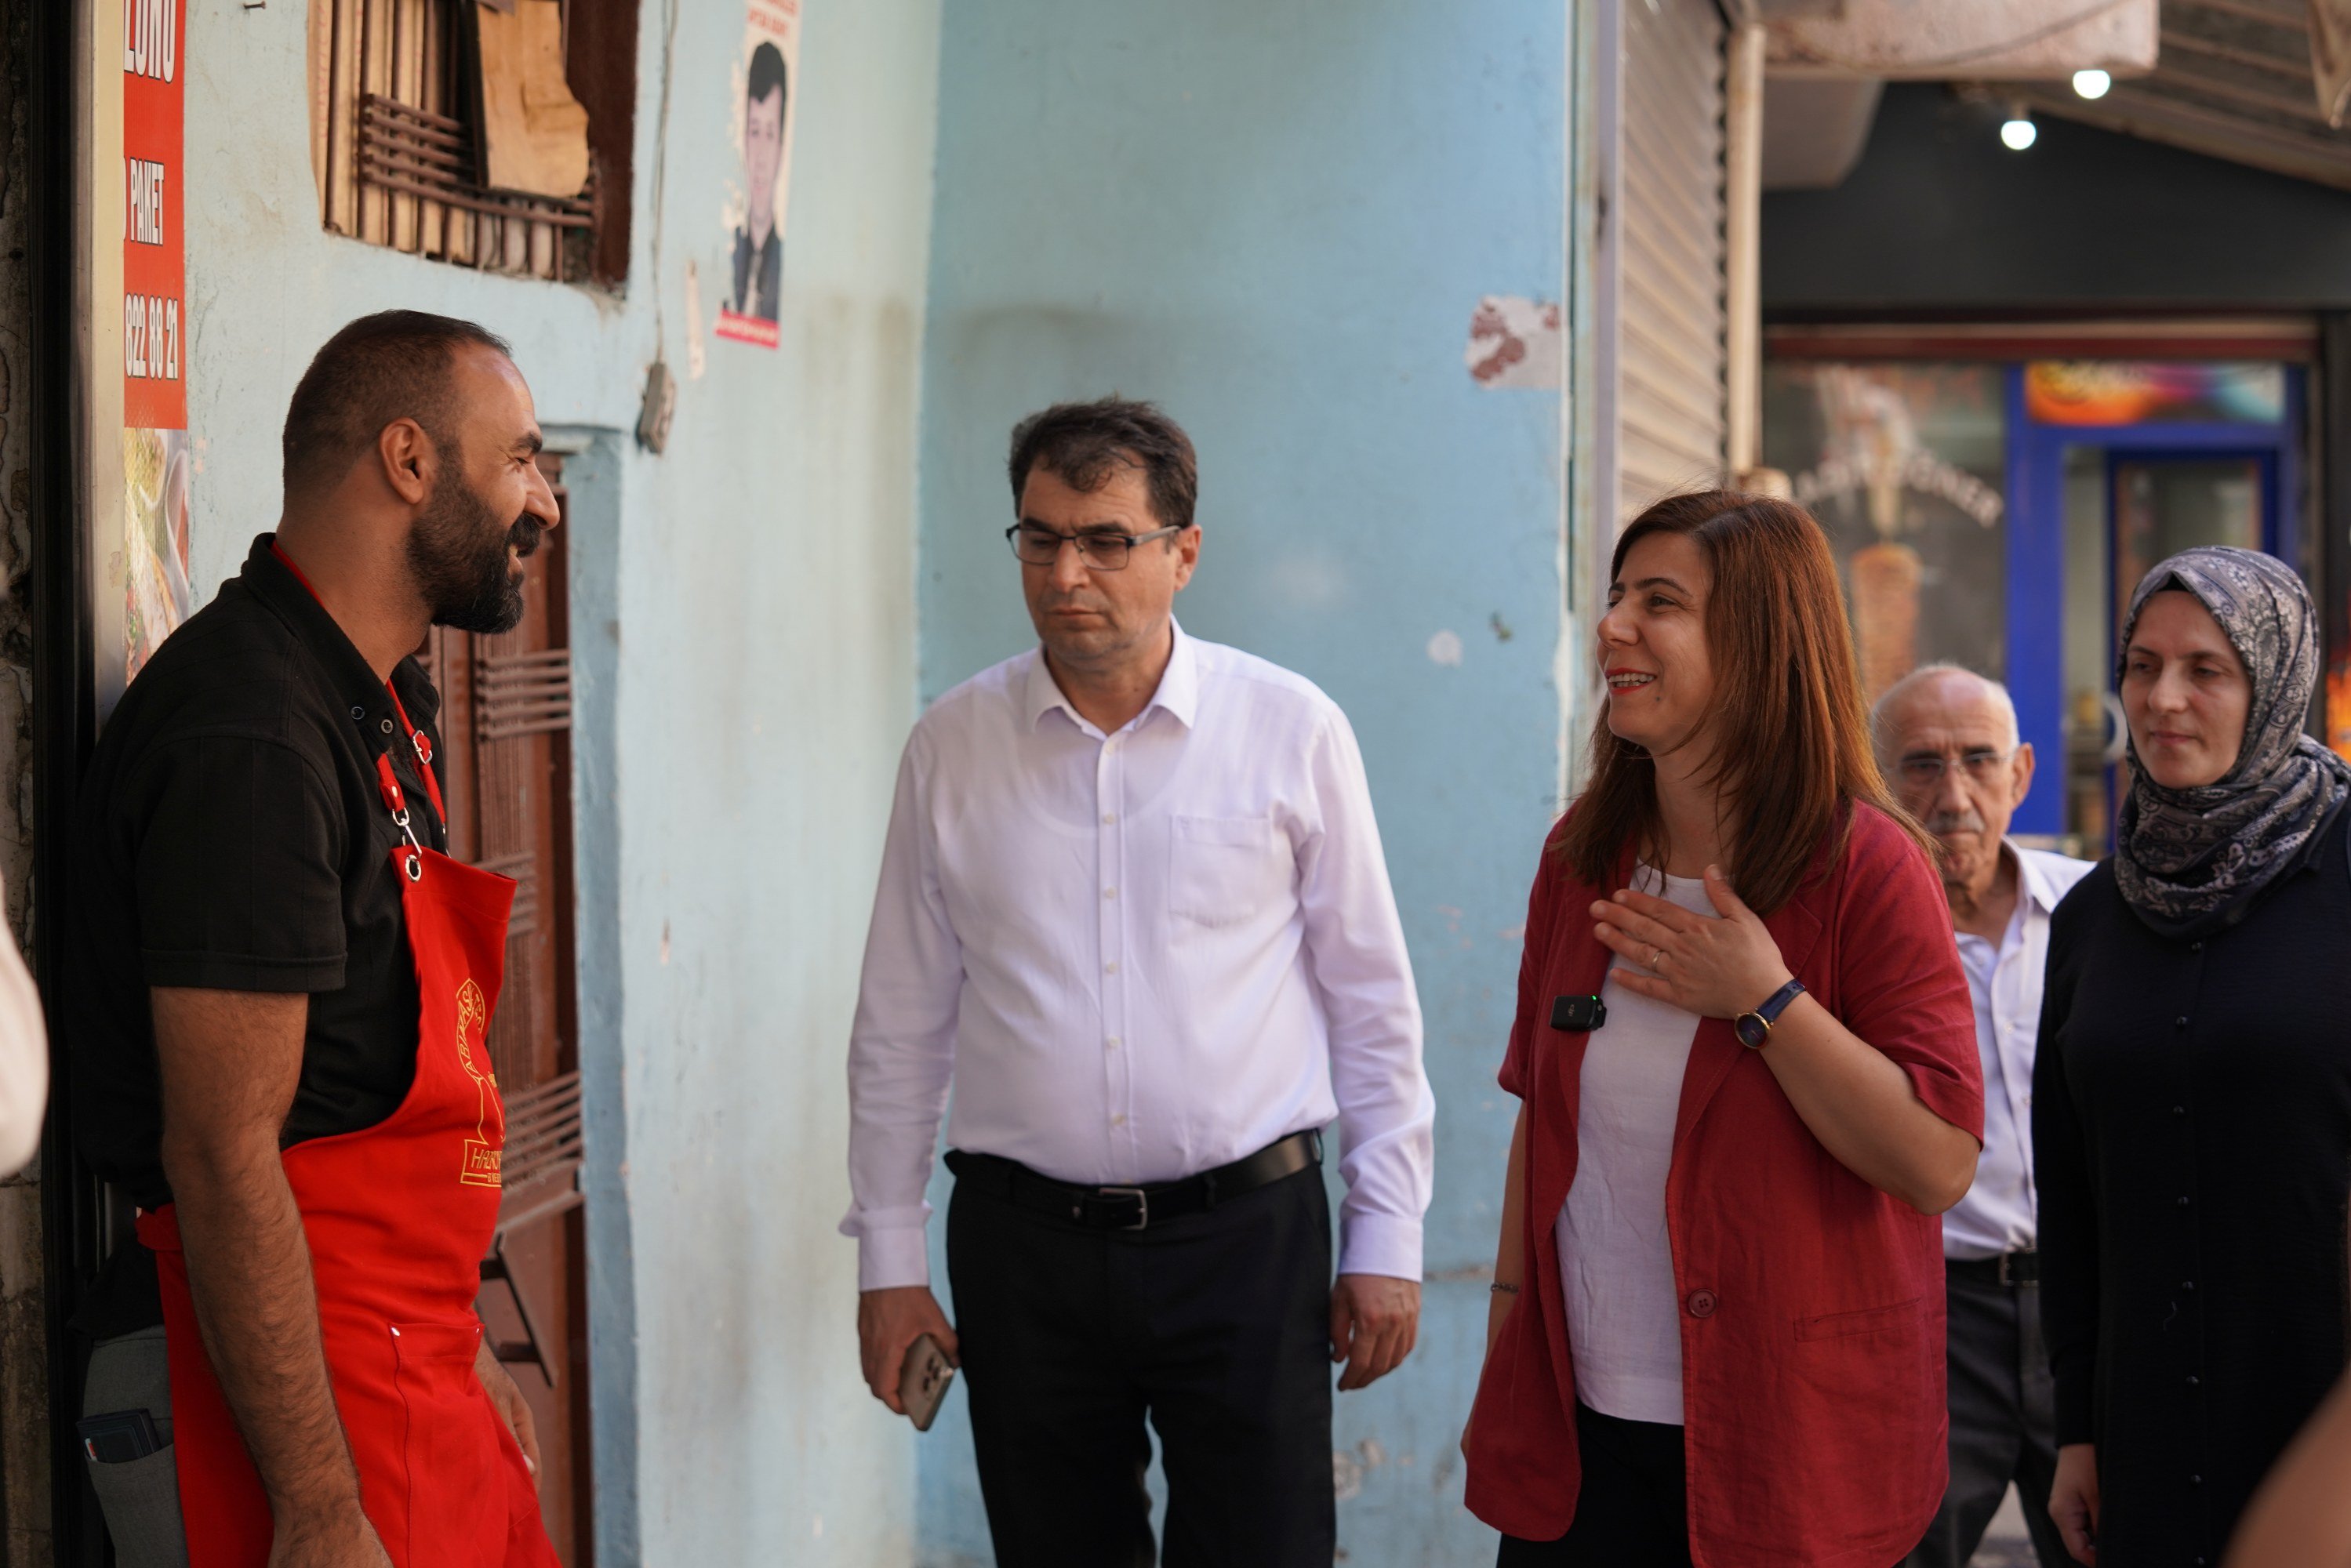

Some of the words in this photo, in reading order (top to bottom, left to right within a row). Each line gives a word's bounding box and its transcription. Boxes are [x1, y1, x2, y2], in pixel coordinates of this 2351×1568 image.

[129, 157, 164, 246] PAKET
[125, 292, 147, 378] 822
[149, 295, 163, 379] 88
[165, 297, 178, 380] 21
